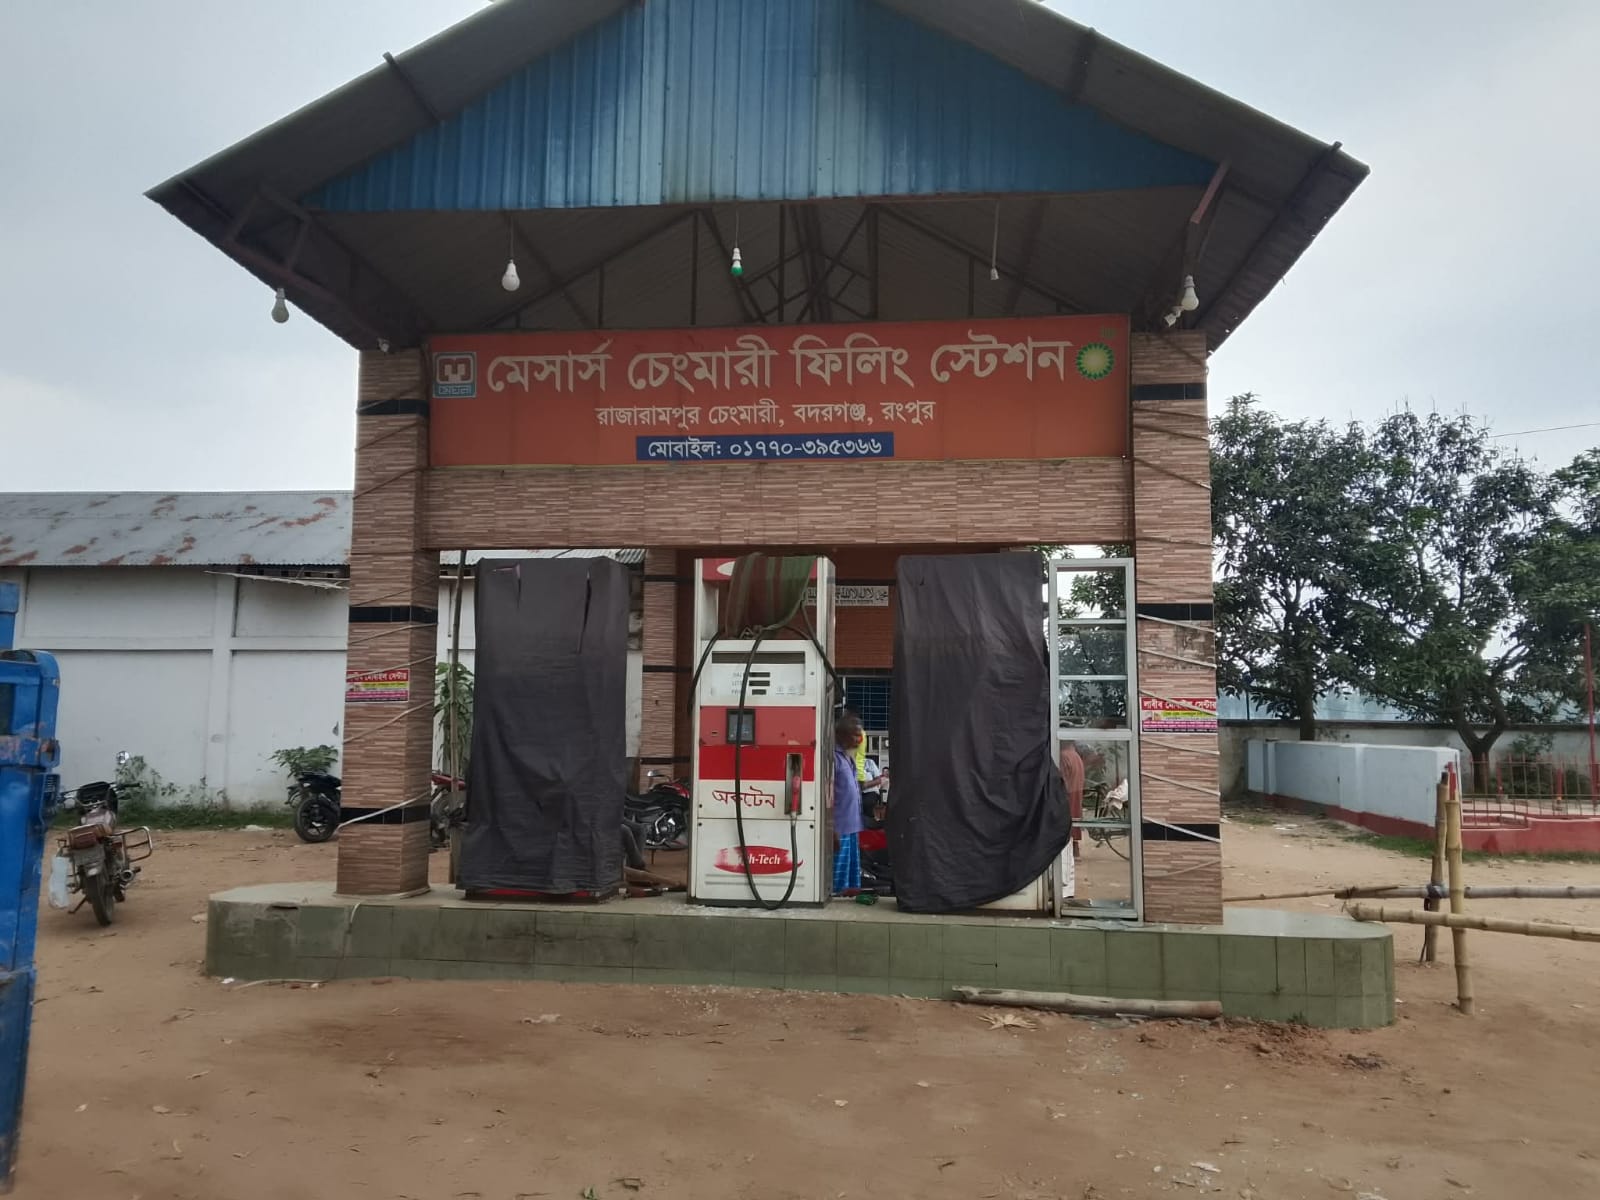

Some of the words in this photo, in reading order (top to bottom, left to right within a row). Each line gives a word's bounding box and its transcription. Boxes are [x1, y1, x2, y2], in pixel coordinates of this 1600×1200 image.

[487, 338, 613, 393] মেসার্স
[627, 334, 778, 393] চেংমারী
[788, 332, 915, 388] ফিলিং
[930, 329, 1073, 383] স্টেশন
[595, 404, 702, 431] রাজারামপুর
[708, 398, 785, 428] চেংমারী,
[792, 400, 873, 426] বদরগঞ্জ,
[880, 400, 936, 425] রংপুর
[647, 436, 722, 460] মোবাইল:
[729, 438, 882, 457] ০১৭৭০-৩৯৫৩৬৬
[712, 785, 776, 809] অকটেন
